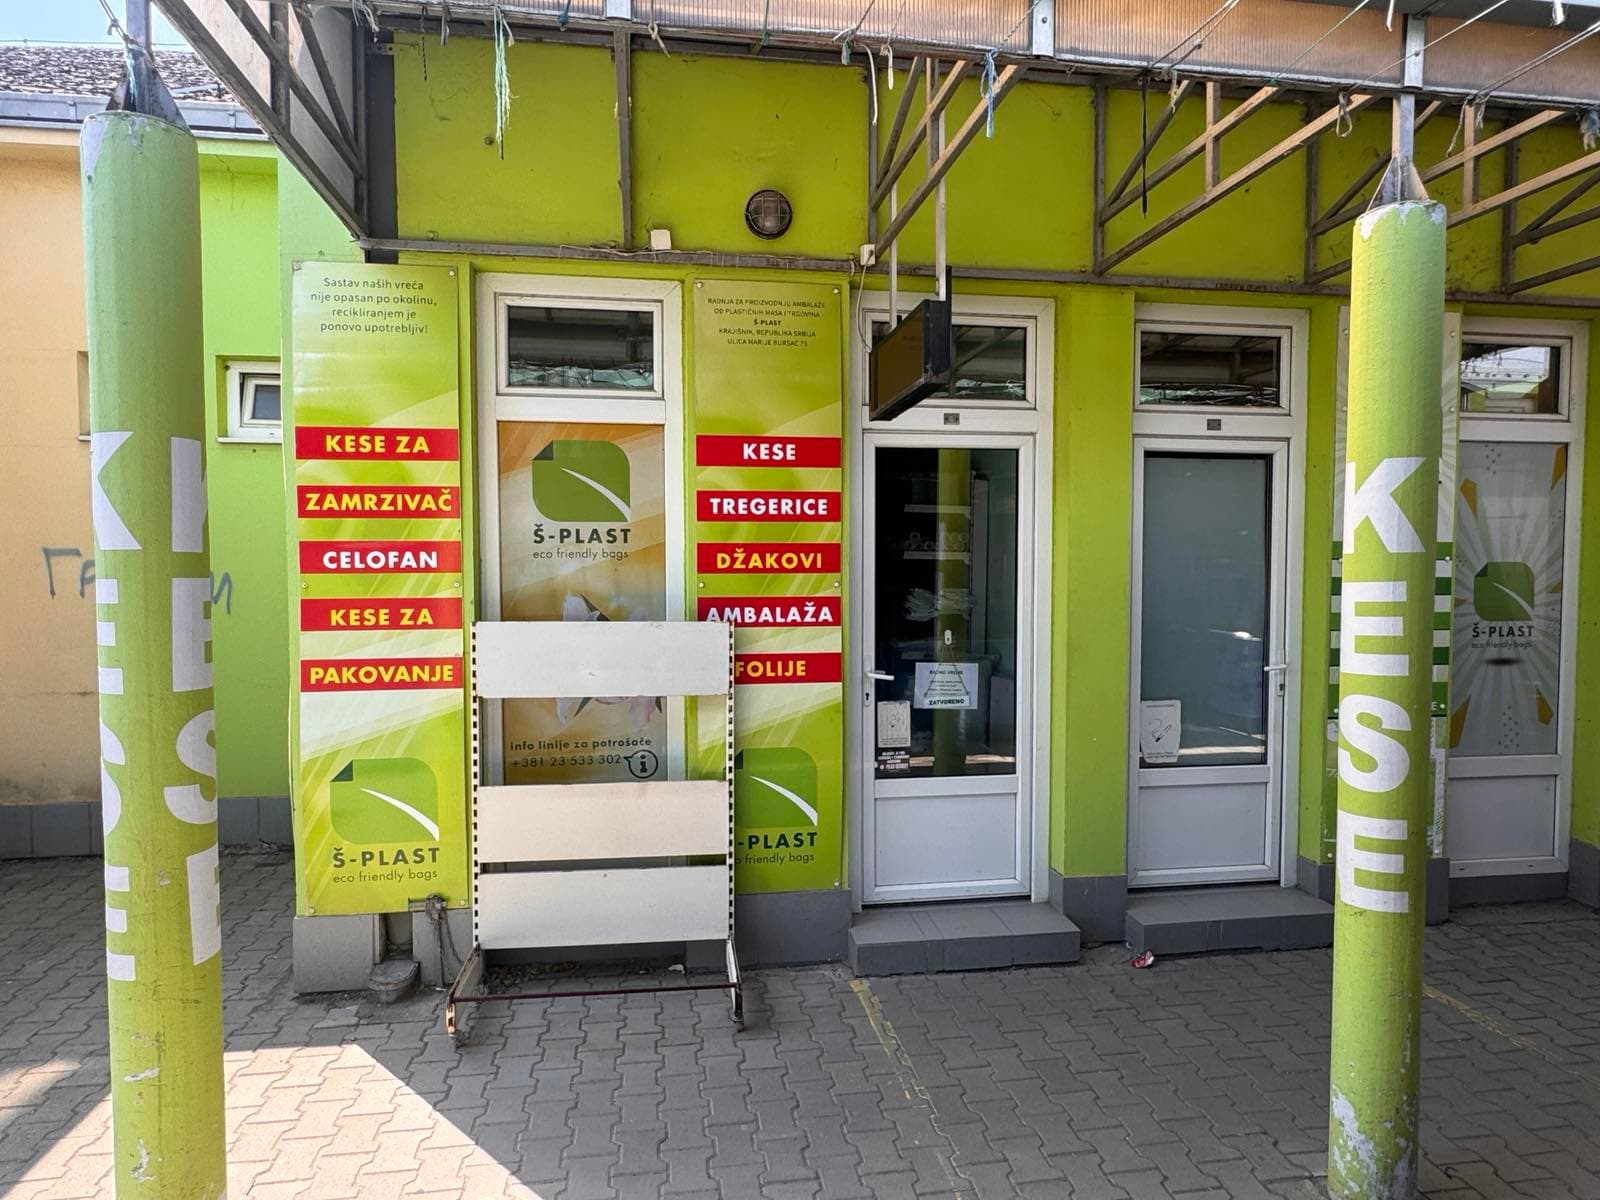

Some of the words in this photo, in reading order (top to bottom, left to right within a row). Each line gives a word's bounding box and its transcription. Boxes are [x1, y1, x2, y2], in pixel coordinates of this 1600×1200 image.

[324, 277, 359, 288] Sastav
[363, 279, 392, 288] naših
[395, 280, 424, 290] vreća
[311, 292, 331, 303] nije
[334, 295, 373, 304] opasan
[377, 296, 390, 305] po
[393, 295, 437, 306] okolinu,
[332, 309, 404, 319] recikliranjem
[406, 310, 417, 320] je
[320, 323, 361, 333] ponovo
[364, 323, 428, 335] upotrebljiv!
[326, 435, 386, 453] KESE
[396, 436, 430, 453] ZA
[742, 443, 796, 460] KESE
[305, 488, 452, 511] ZAMRZIVAČ
[710, 497, 828, 515] TREGERICE
[533, 523, 631, 545] Š-PLAST
[323, 551, 438, 569] CELOFAN
[533, 550, 553, 559] eco
[557, 548, 598, 560] friendly
[602, 548, 629, 560] bags
[716, 548, 822, 569] DŽAKOVI
[331, 609, 390, 626] KESE
[400, 608, 434, 625] ZA
[706, 602, 833, 623] AMBALAŽA
[1472, 623, 1534, 638] Š-PLAST
[310, 665, 454, 685] PAKOVANJE
[735, 661, 806, 677] FOLIJE
[1337, 456, 1427, 914] KESE
[510, 740, 535, 751] info
[538, 740, 570, 751] linije
[574, 740, 588, 749] za
[592, 737, 652, 752] potrošače
[511, 757, 545, 768] +381
[550, 757, 565, 767] 23
[567, 755, 594, 766] 533
[598, 755, 621, 765] 302
[737, 832, 818, 849] -PLAST
[333, 847, 440, 868] Š-PLAST
[745, 854, 785, 865] friendly
[789, 853, 814, 863] bags
[333, 875, 354, 883] eco
[359, 870, 405, 882] friendly
[408, 869, 438, 880] bags
